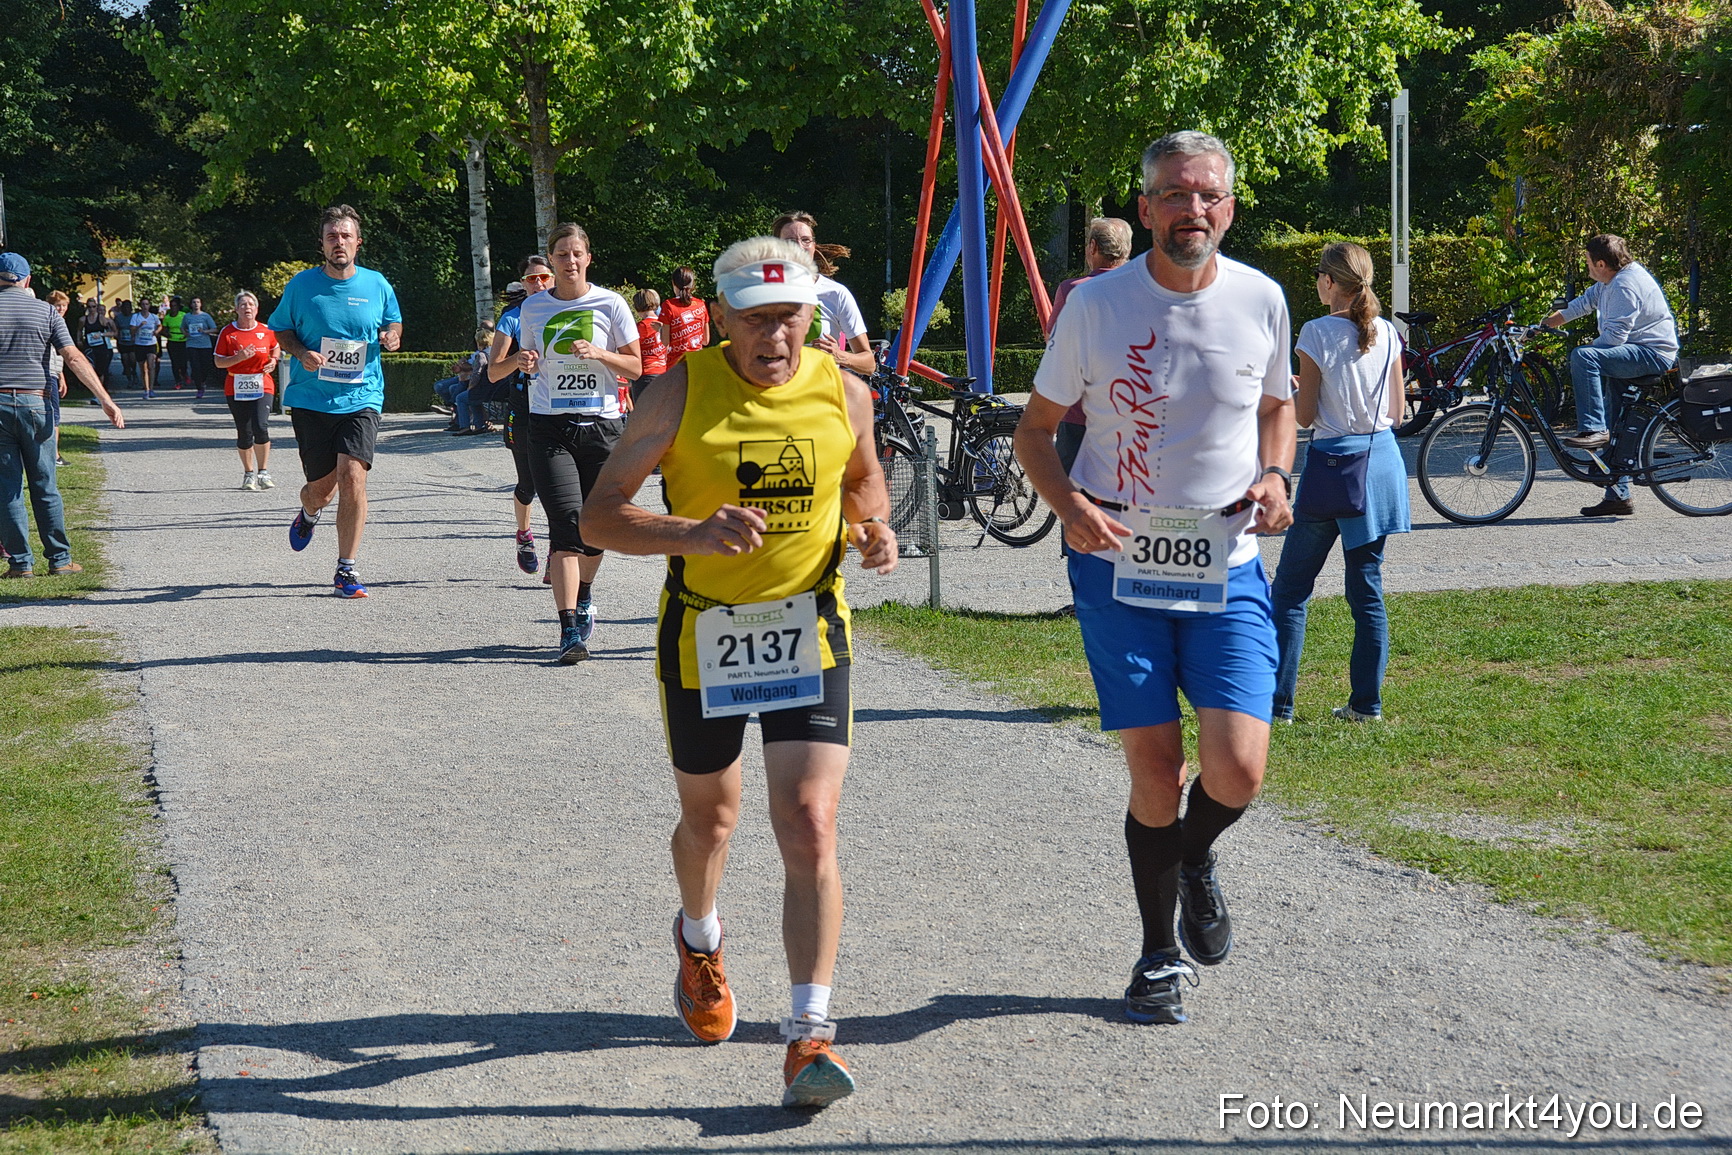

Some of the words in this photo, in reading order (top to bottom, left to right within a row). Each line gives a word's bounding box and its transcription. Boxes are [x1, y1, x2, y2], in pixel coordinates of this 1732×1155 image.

[327, 350, 360, 365] 2483
[238, 381, 259, 389] 2339
[557, 374, 597, 390] 2256
[1150, 516, 1198, 529] BOCK
[1132, 535, 1212, 568] 3088
[1138, 568, 1160, 576] PARTL
[1162, 570, 1195, 578] Neumarkt
[1132, 581, 1200, 600] Reinhard
[733, 608, 785, 624] BOCK
[717, 628, 802, 667] 2137
[728, 670, 752, 679] PARTL
[753, 668, 789, 678] Neumarkt
[731, 683, 797, 702] Wolfgang
